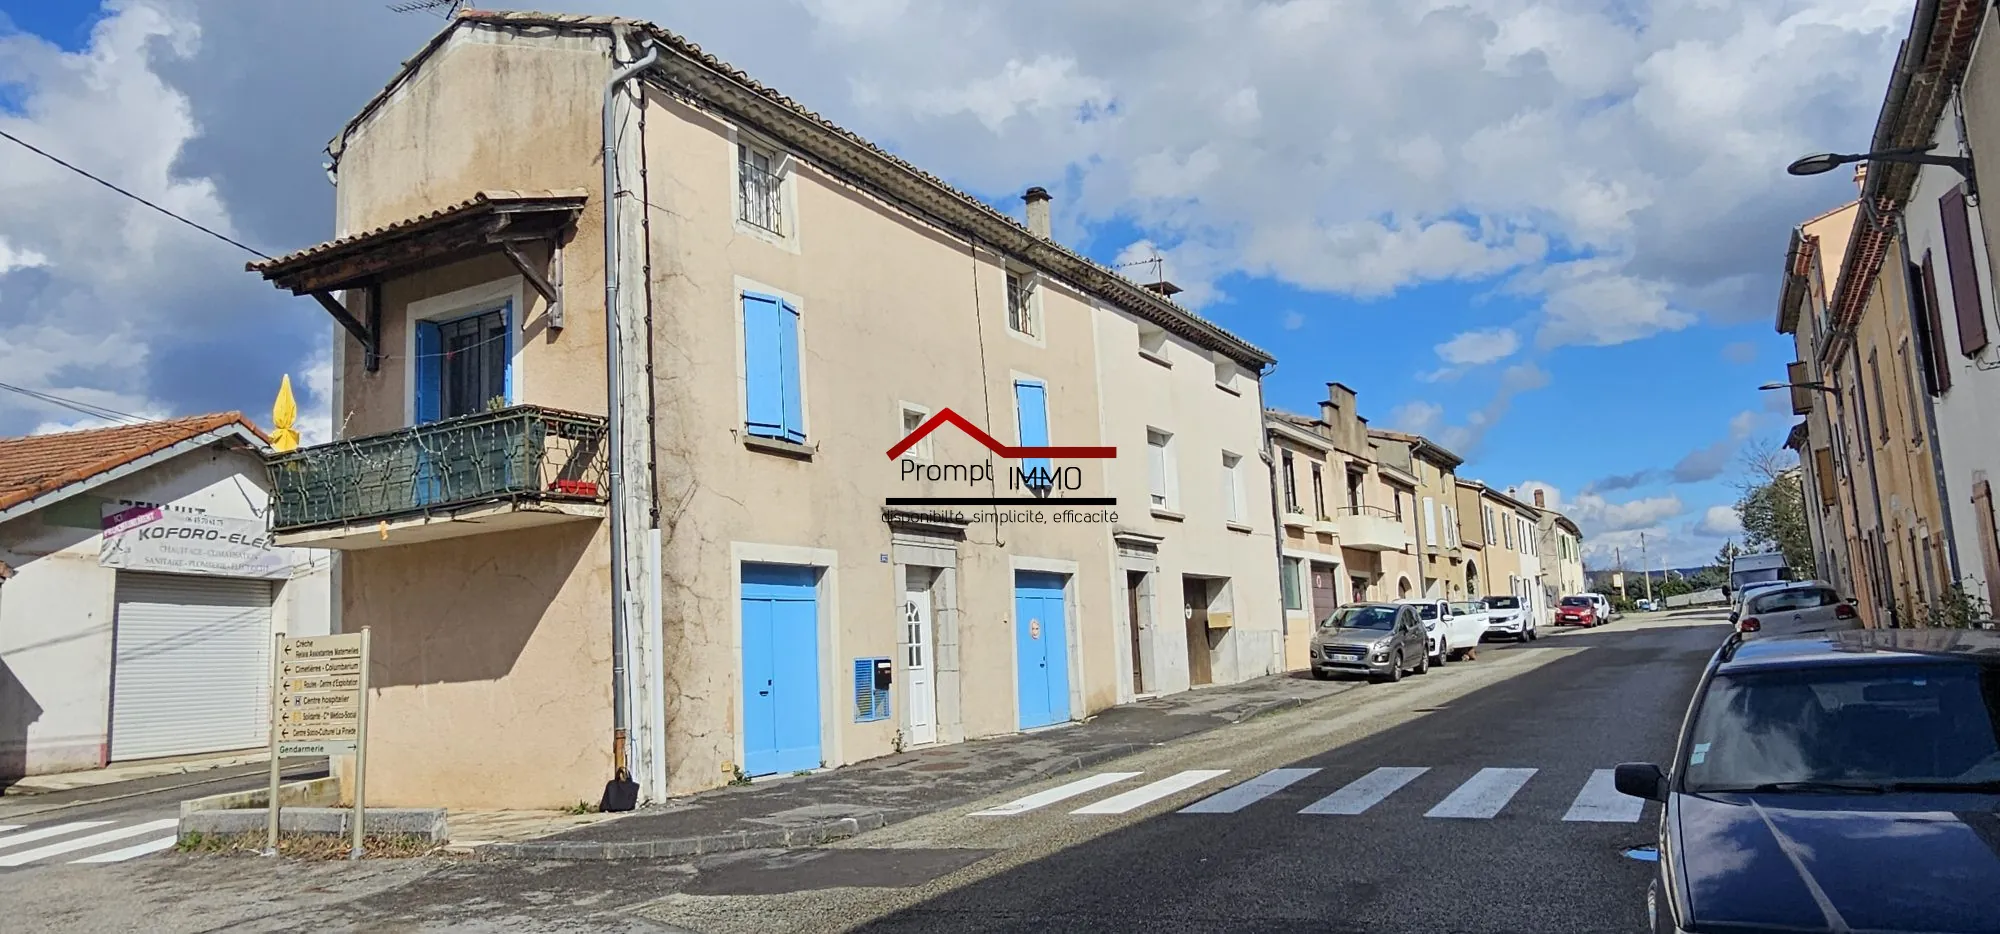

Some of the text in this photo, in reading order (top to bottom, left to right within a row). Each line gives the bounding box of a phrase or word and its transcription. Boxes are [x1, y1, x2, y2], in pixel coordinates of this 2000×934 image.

[325, 663, 358, 671] Columbarium
[303, 697, 320, 705] Centre
[322, 695, 350, 705] hospitalier
